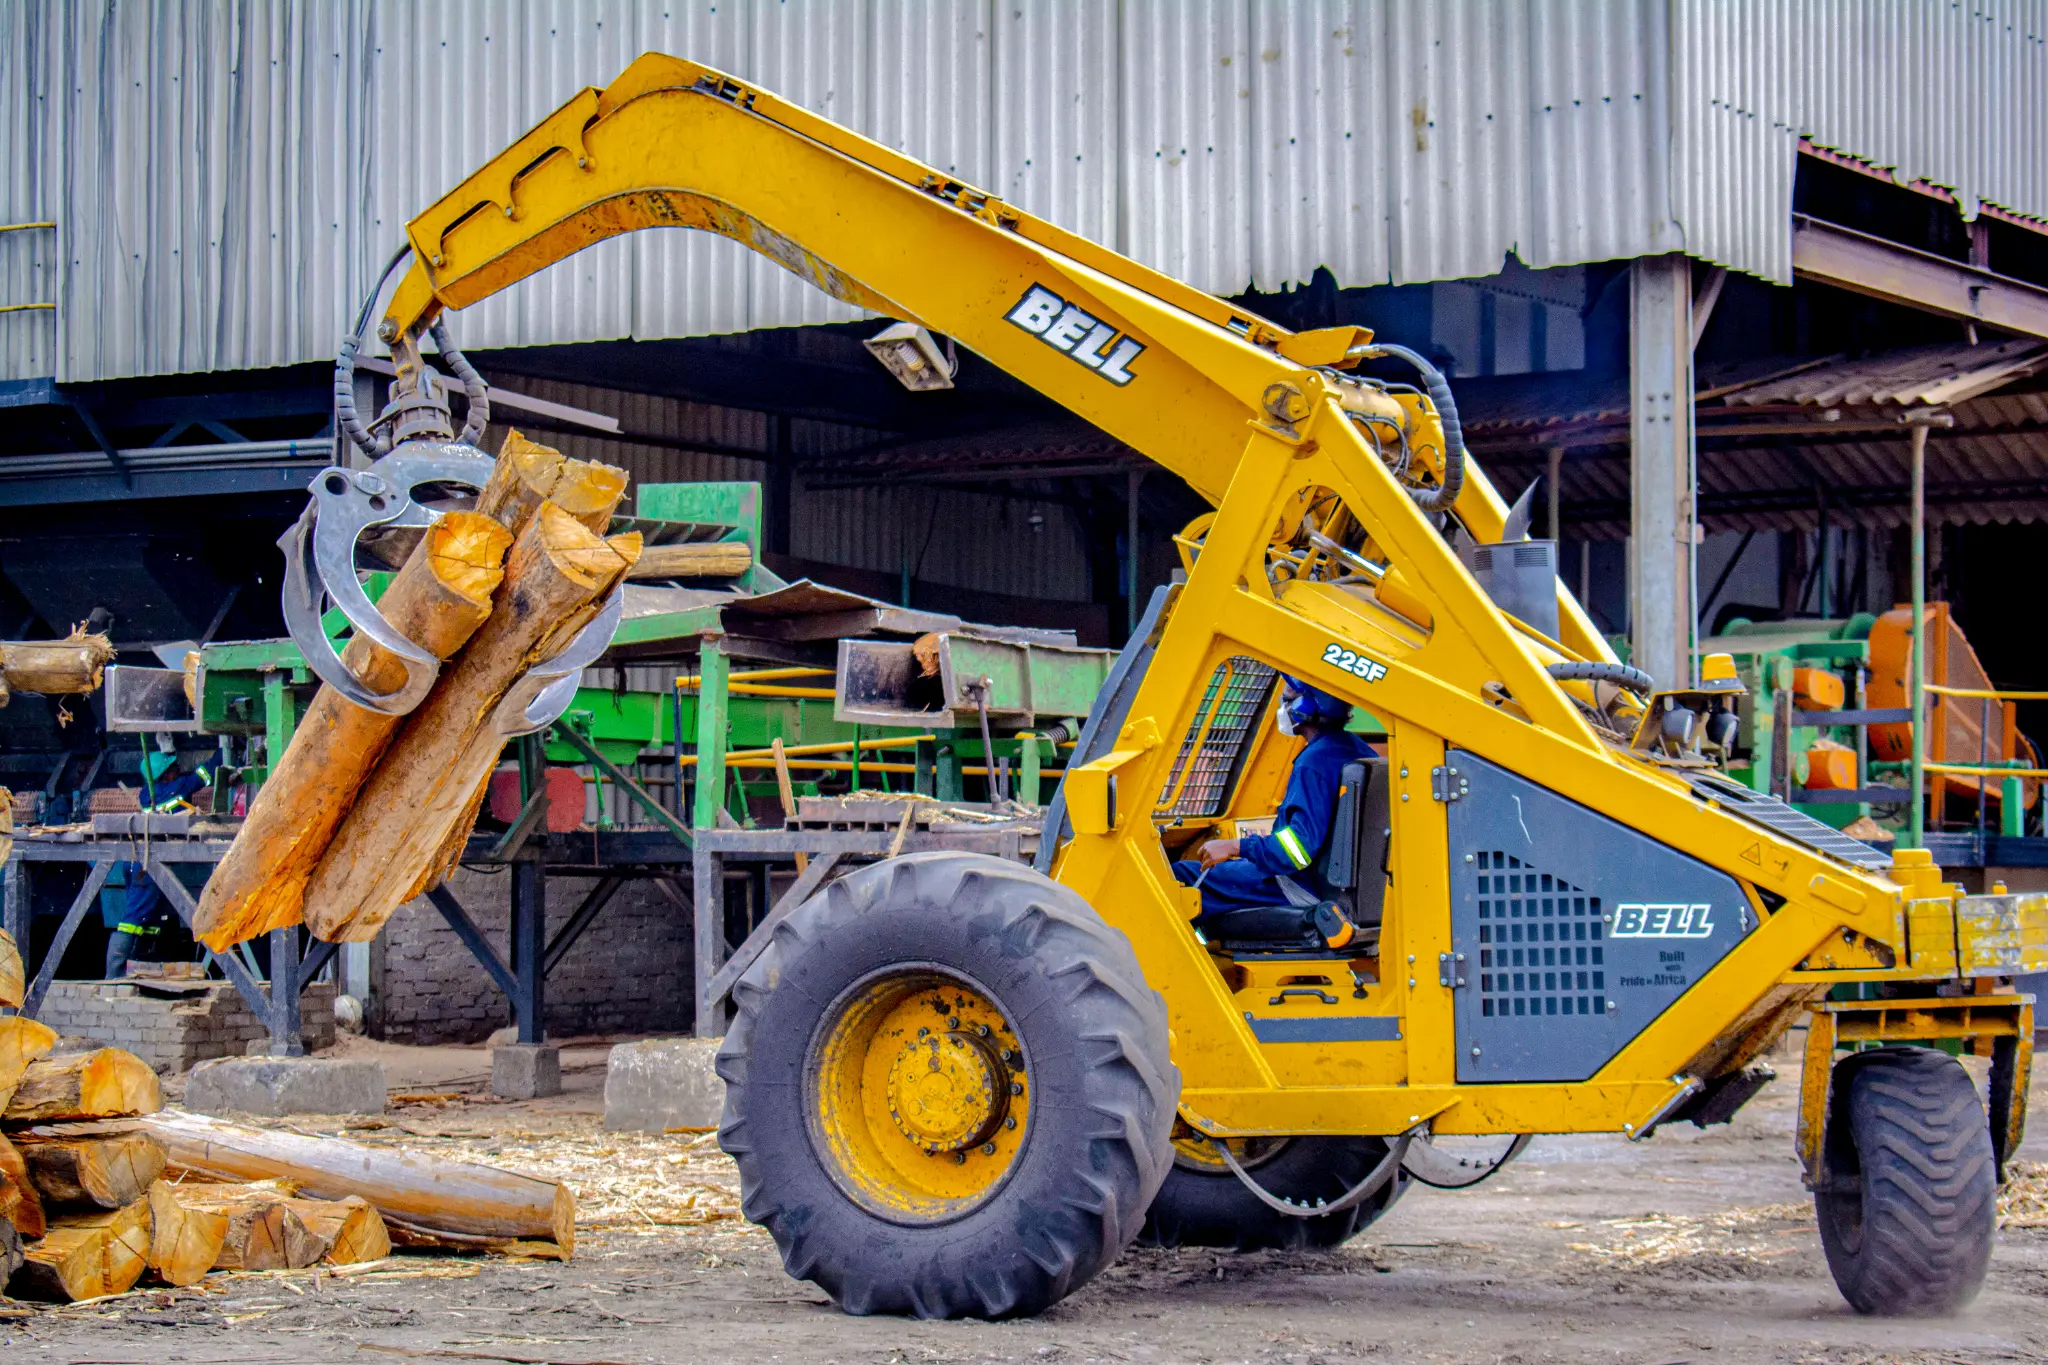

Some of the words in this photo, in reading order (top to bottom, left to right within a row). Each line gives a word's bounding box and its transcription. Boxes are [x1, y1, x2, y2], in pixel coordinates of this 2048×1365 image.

[1002, 281, 1148, 388] BELL
[1321, 643, 1388, 684] 225F
[1609, 904, 1714, 938] BELL
[1659, 951, 1685, 962] Built
[1620, 976, 1645, 986] Pride
[1654, 974, 1686, 986] Africa
